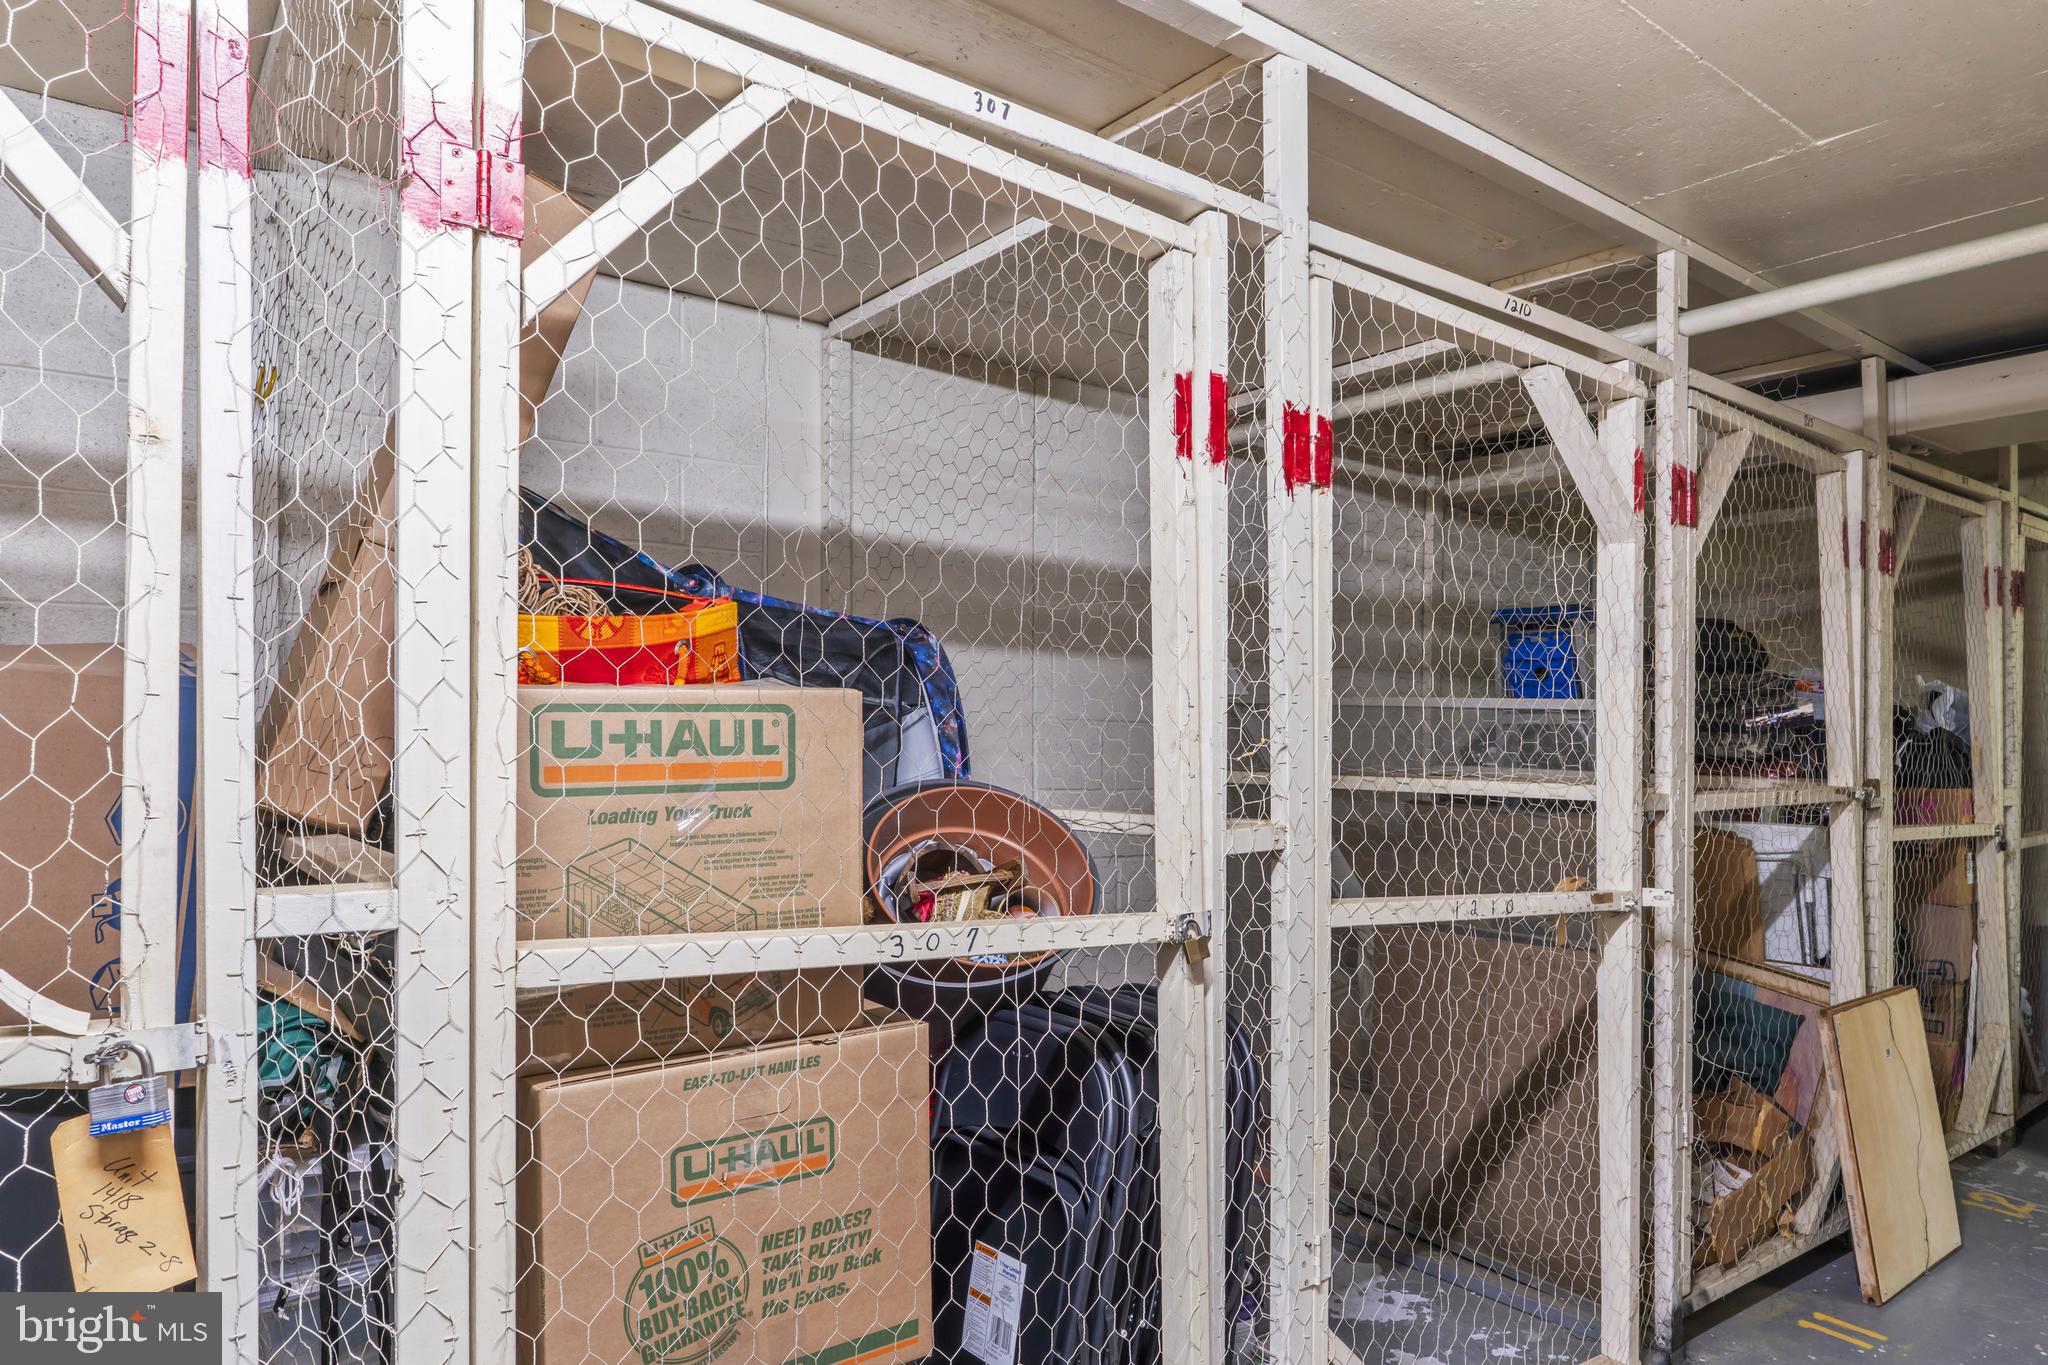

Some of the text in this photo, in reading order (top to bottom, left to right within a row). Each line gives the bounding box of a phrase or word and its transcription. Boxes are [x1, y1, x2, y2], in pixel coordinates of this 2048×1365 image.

[973, 90, 1010, 120] 307
[1504, 297, 1532, 317] 1210
[551, 719, 780, 759] U-HAUL
[587, 807, 658, 826] Loading
[708, 803, 754, 820] Truck
[1455, 898, 1514, 919] 1210
[890, 927, 979, 959] 307
[767, 1055, 821, 1076] HANDLES
[101, 1119, 142, 1132] Master
[683, 1127, 825, 1182] U-HAUL
[104, 1157, 158, 1187] Unit
[92, 1181, 144, 1210] 1418
[760, 1207, 873, 1253] NEED BOXES?
[761, 1228, 873, 1275] TAKE PLENTY!
[638, 1245, 729, 1310] 100%
[762, 1247, 882, 1297] We'll Buy Back
[637, 1275, 742, 1342] BUY-BACK
[761, 1281, 850, 1319] the Extras.
[712, 1328, 742, 1359] RECEIPT
